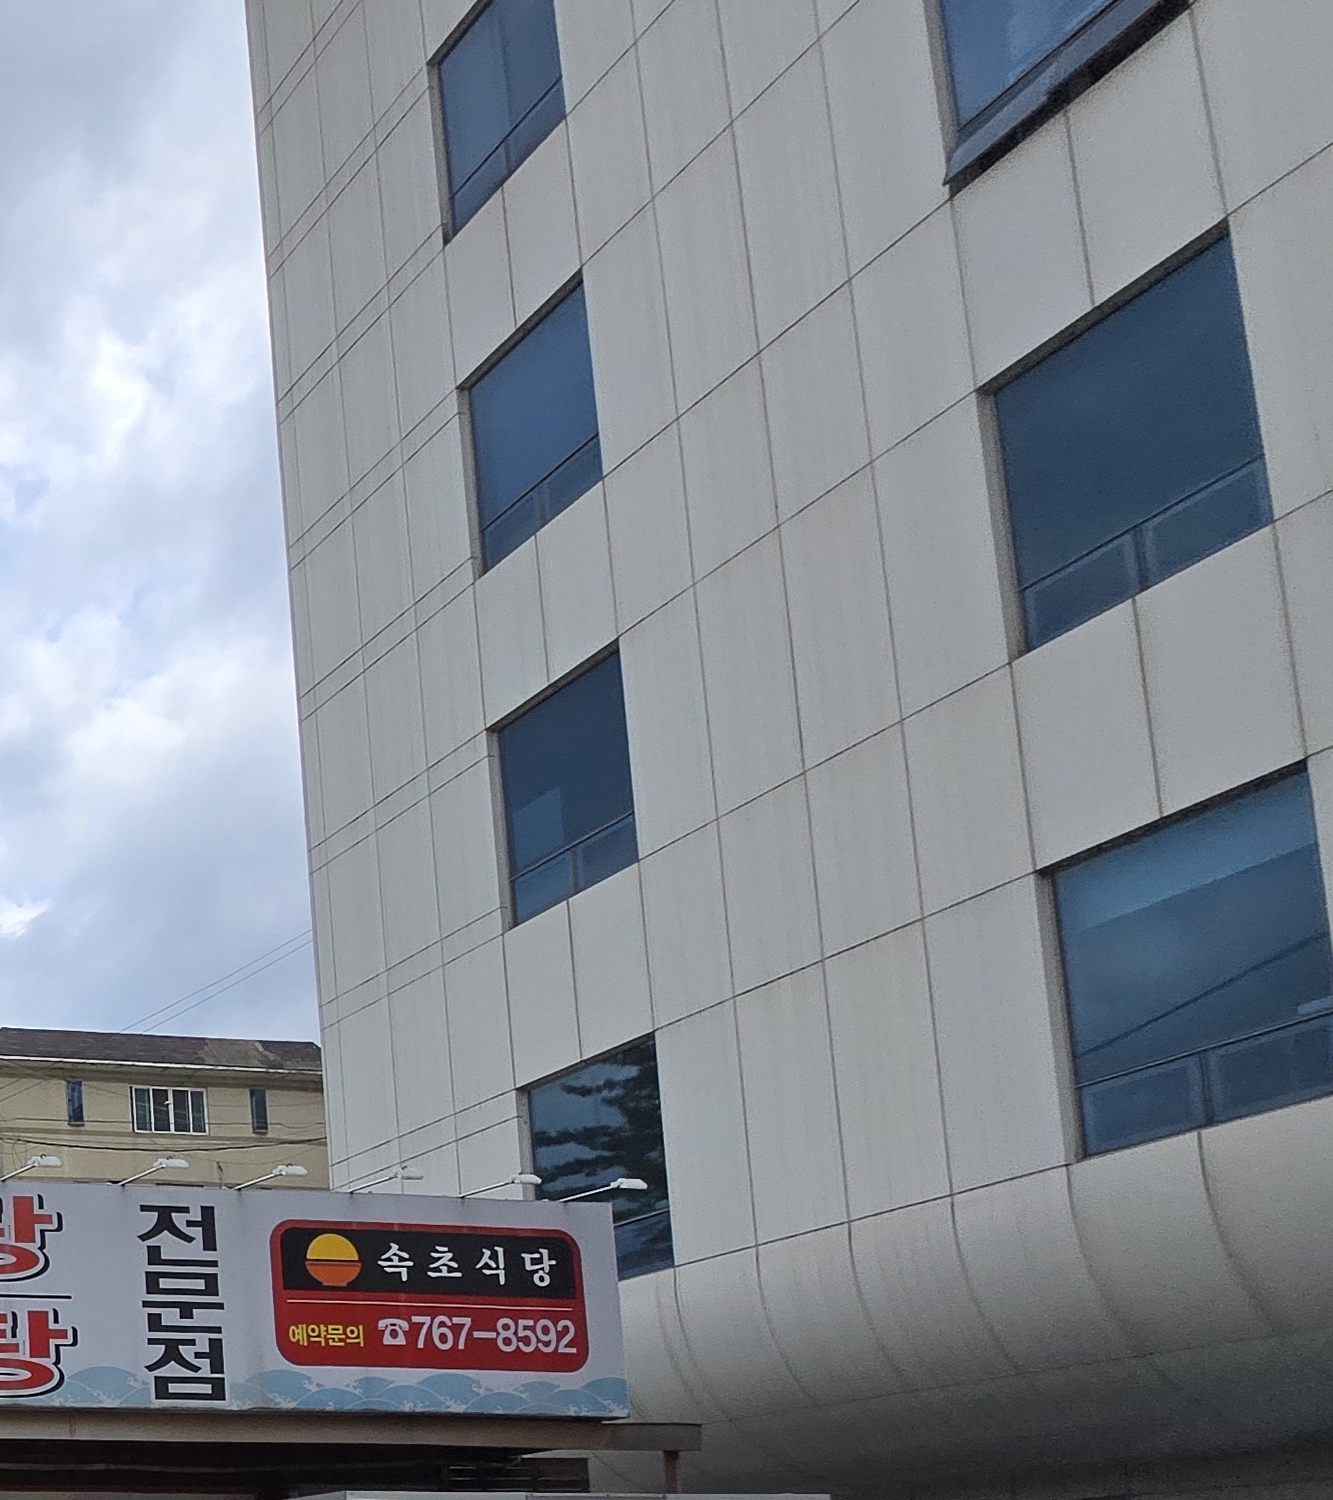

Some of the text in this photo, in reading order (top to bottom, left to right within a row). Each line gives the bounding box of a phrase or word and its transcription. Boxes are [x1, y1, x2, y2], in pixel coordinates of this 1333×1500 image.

[377, 1242, 557, 1288] 속초식당
[136, 1203, 228, 1402] 전문점
[289, 1314, 364, 1347] 예약문의
[410, 1315, 578, 1353] 767-8592
